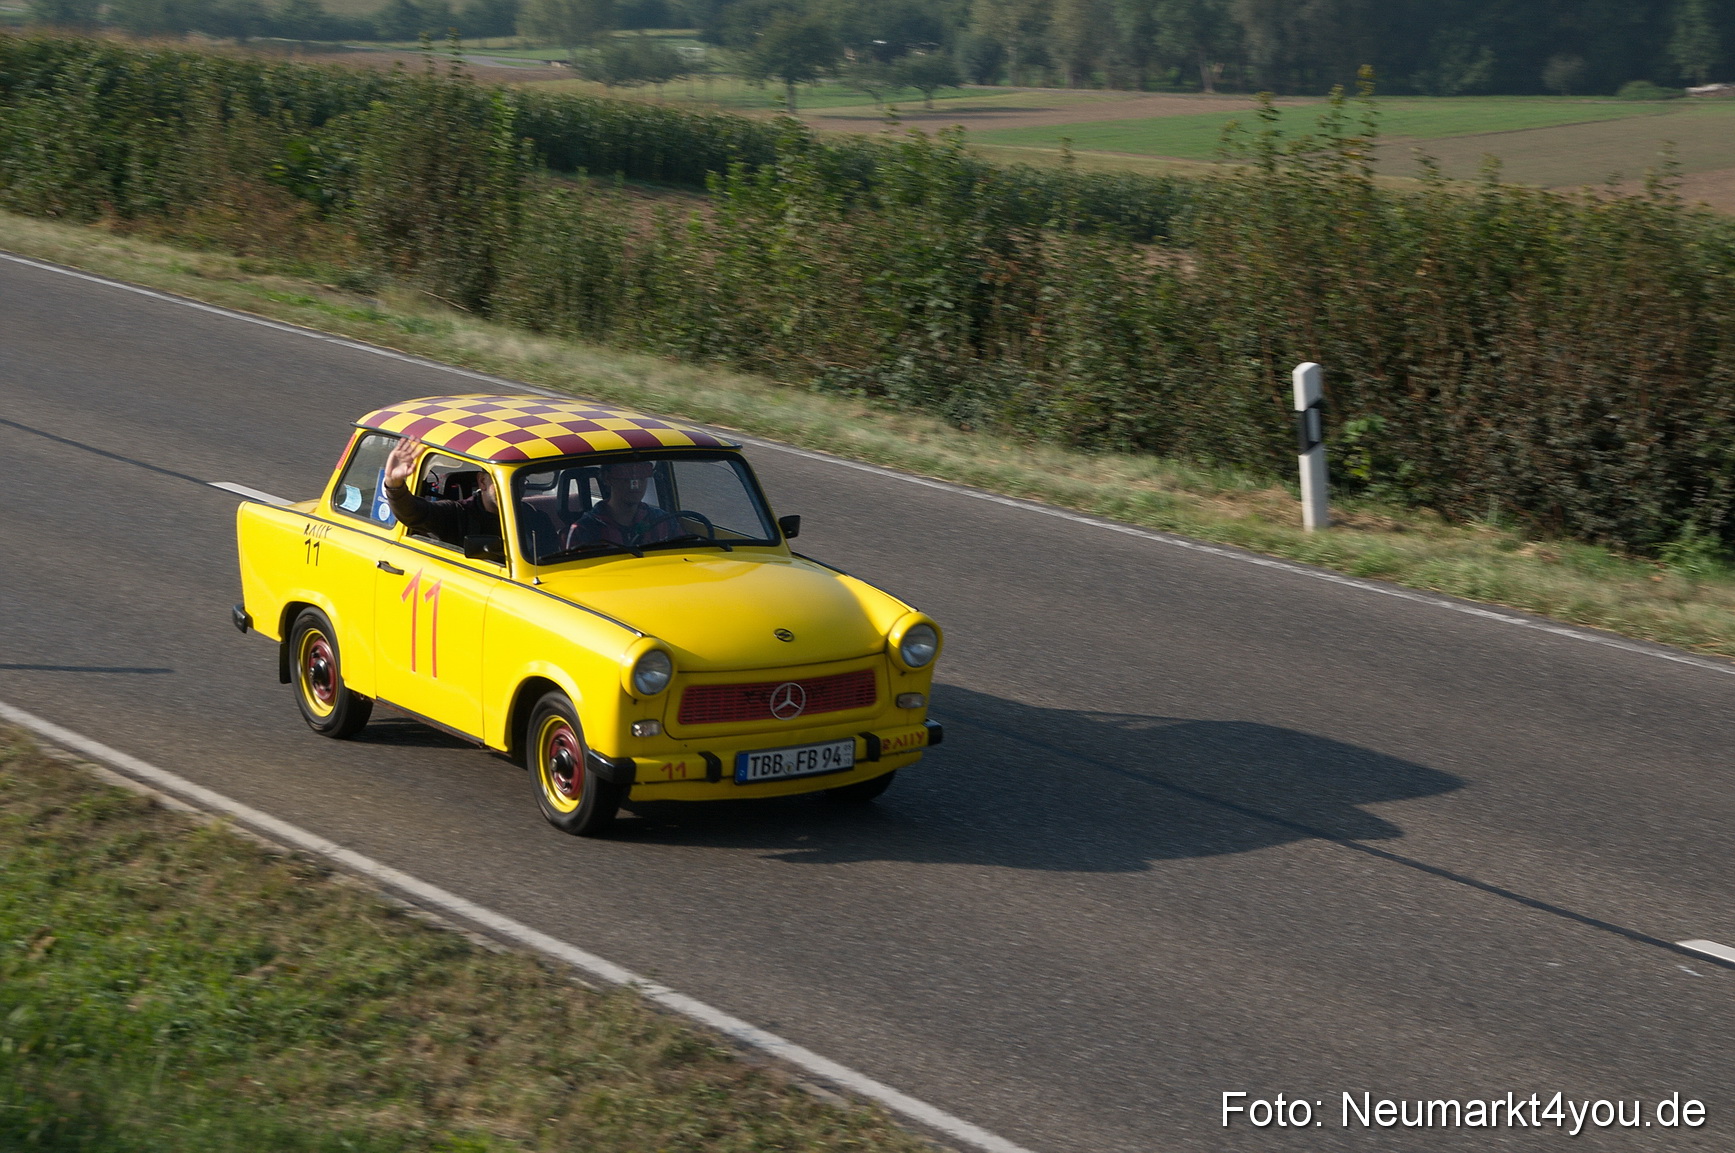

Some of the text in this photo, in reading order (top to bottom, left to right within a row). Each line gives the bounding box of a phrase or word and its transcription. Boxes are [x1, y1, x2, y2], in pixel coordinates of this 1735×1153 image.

[305, 540, 321, 567] 11
[401, 568, 443, 679] 11
[661, 762, 687, 780] 11
[751, 746, 843, 778] TBB FB 94
